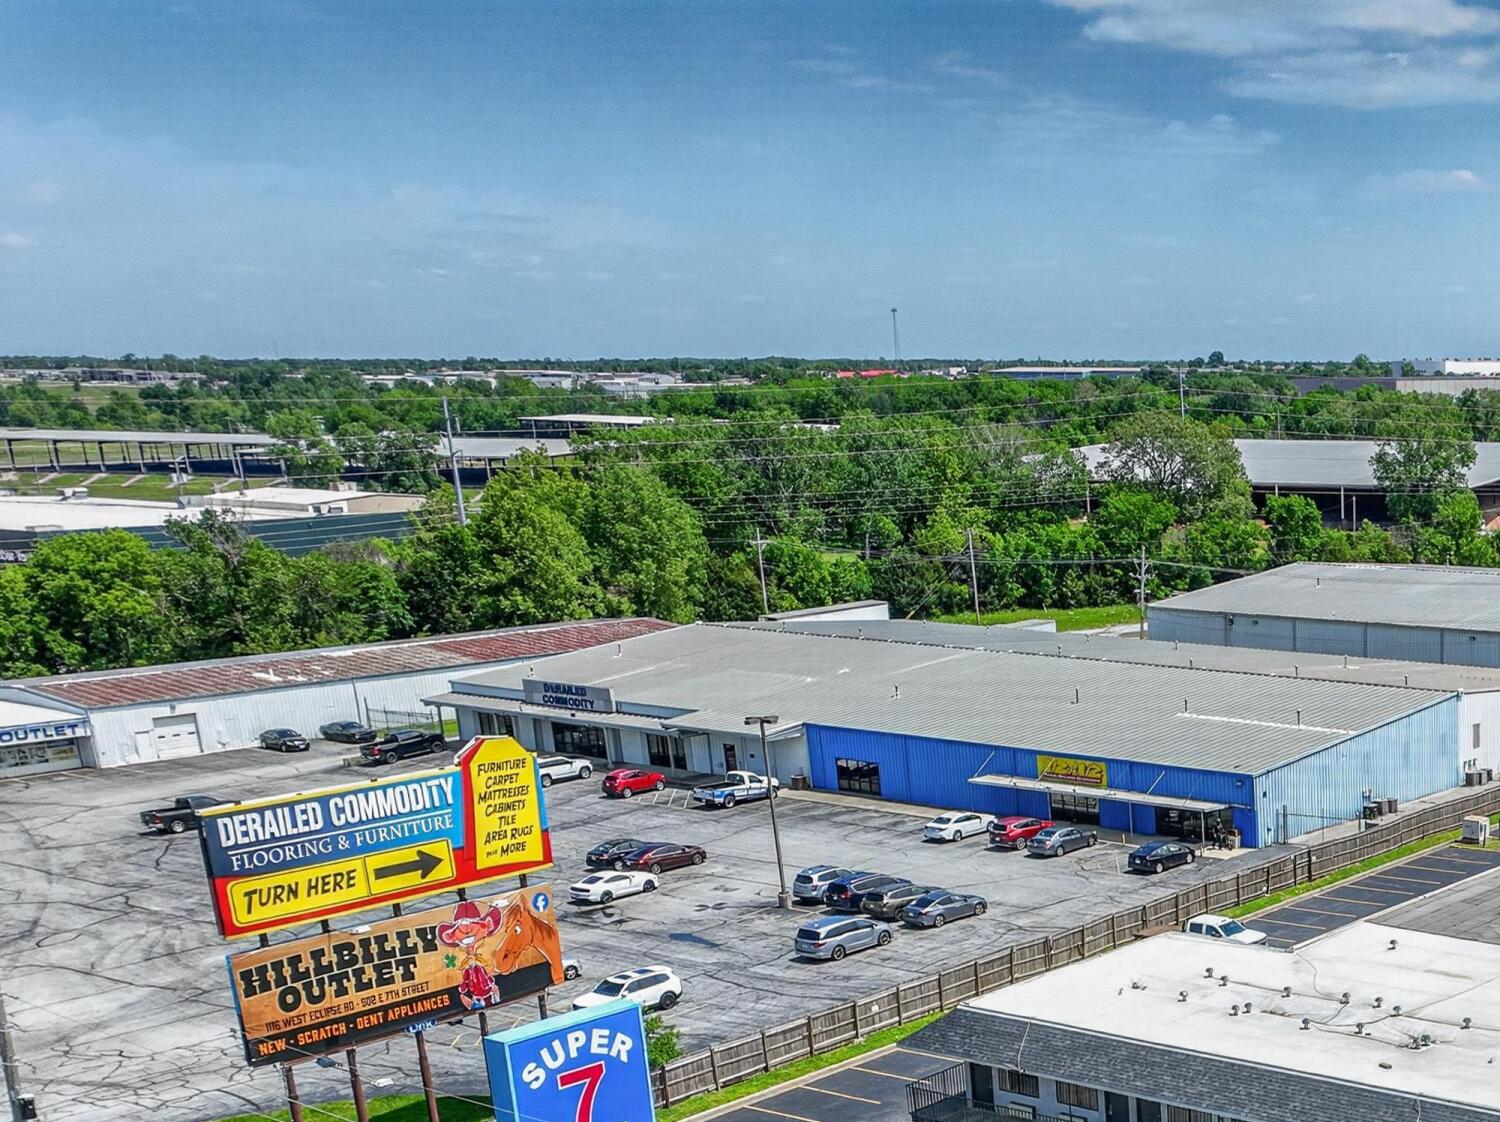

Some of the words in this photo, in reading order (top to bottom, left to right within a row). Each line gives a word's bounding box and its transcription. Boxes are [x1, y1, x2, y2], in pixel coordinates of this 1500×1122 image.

[0, 723, 78, 743] OUTLET
[477, 758, 527, 777] FURNITURE
[485, 773, 519, 789] CARPET
[216, 801, 324, 848] DERAILED
[328, 776, 454, 827] COMMODITY
[478, 785, 530, 805] MATTRESSES
[485, 799, 526, 817] CABINETS
[484, 829, 508, 846] AREA
[510, 825, 534, 841] RUGS
[498, 814, 517, 829] TILE
[230, 837, 332, 872] FLOORING
[337, 835, 350, 850] &
[355, 814, 454, 847] FURNITURE
[500, 841, 527, 857] MORE
[243, 881, 299, 915] TURN
[306, 868, 357, 898] HERE
[239, 925, 439, 998] HILLBILLY
[278, 956, 417, 1013] OUTLET
[282, 1013, 307, 1029] WEST
[309, 1005, 342, 1021] ECLIPSE
[344, 1001, 354, 1012] RD
[361, 995, 376, 1007] 902
[378, 993, 384, 1002] E
[385, 989, 400, 1000] 7TH
[401, 981, 430, 997] STREET
[258, 1038, 286, 1056] NEW
[297, 1022, 347, 1046] SCRATCH
[356, 1012, 384, 1030] DENT
[388, 994, 450, 1021] APPLIANCES
[521, 1028, 633, 1090] SUPER
